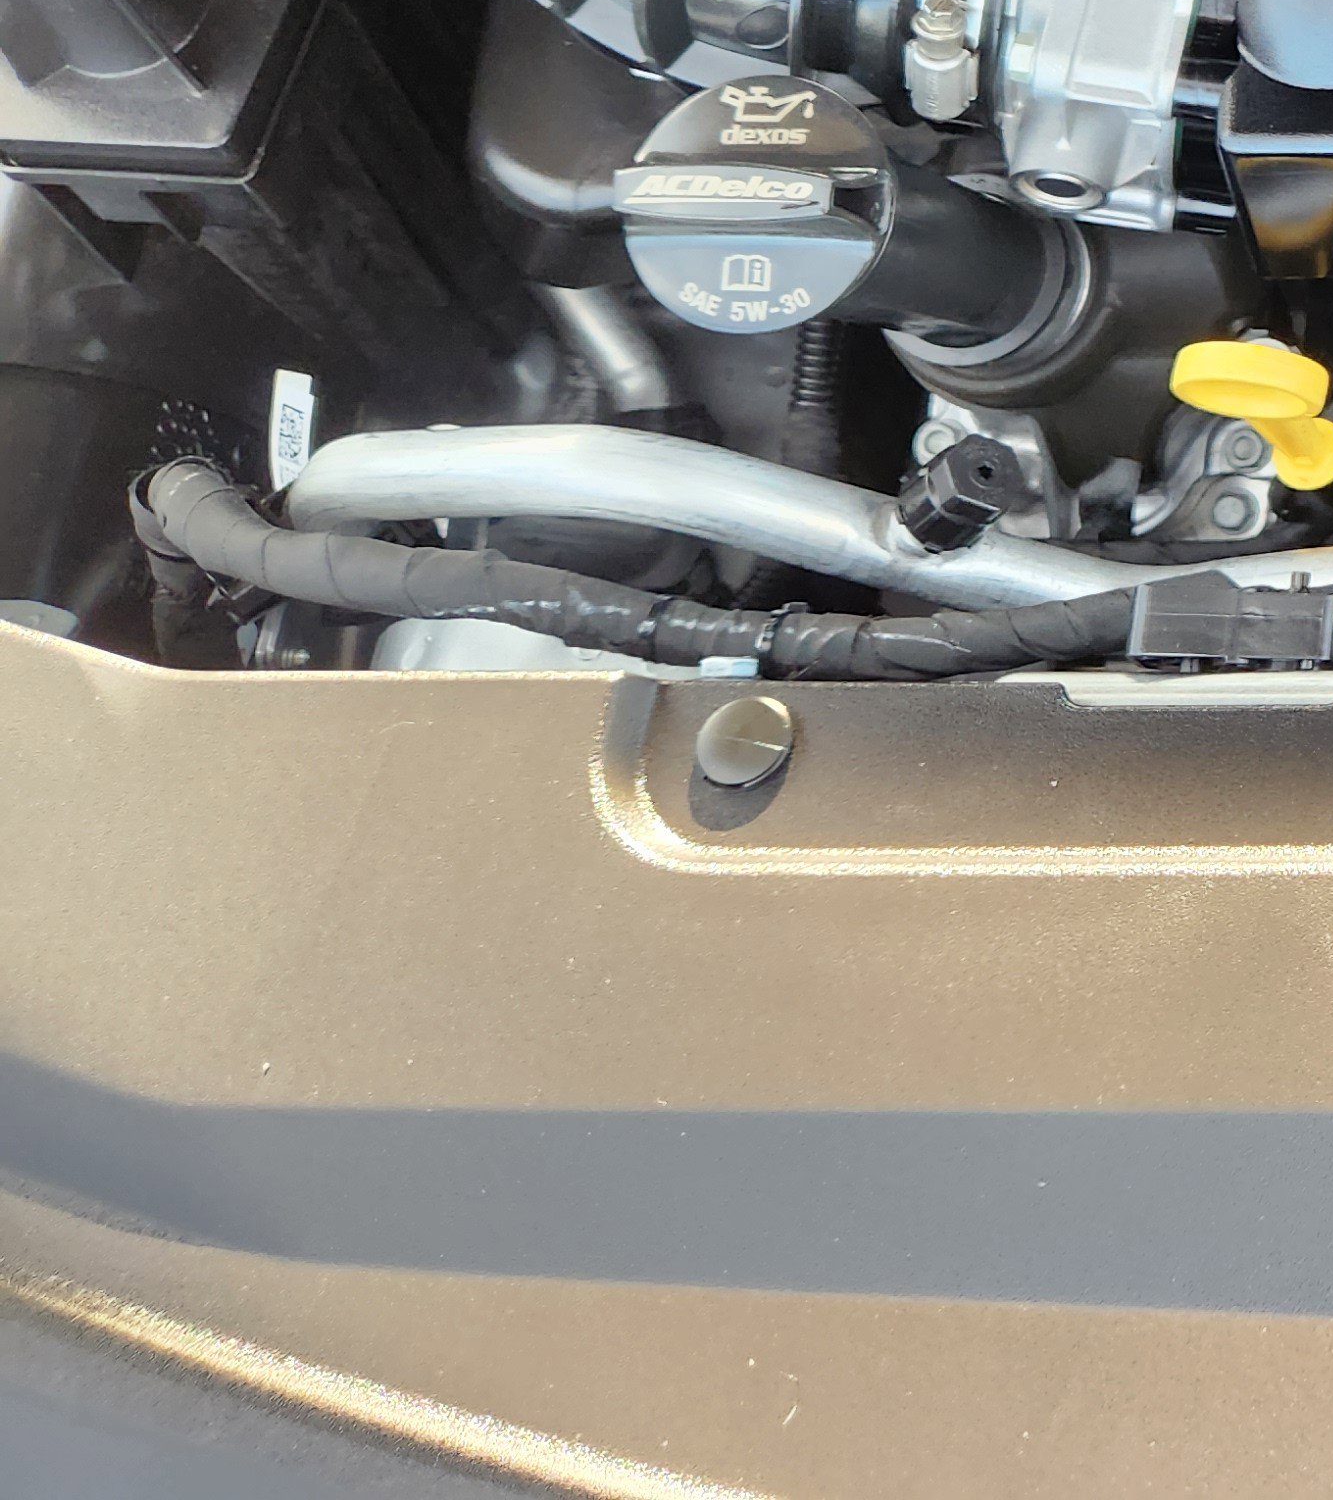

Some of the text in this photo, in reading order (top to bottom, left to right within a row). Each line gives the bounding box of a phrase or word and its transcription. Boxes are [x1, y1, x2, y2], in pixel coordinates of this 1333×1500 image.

[720, 123, 810, 145] dexos
[632, 175, 814, 199] ACDelco
[678, 282, 811, 322] SAE 5W-30
